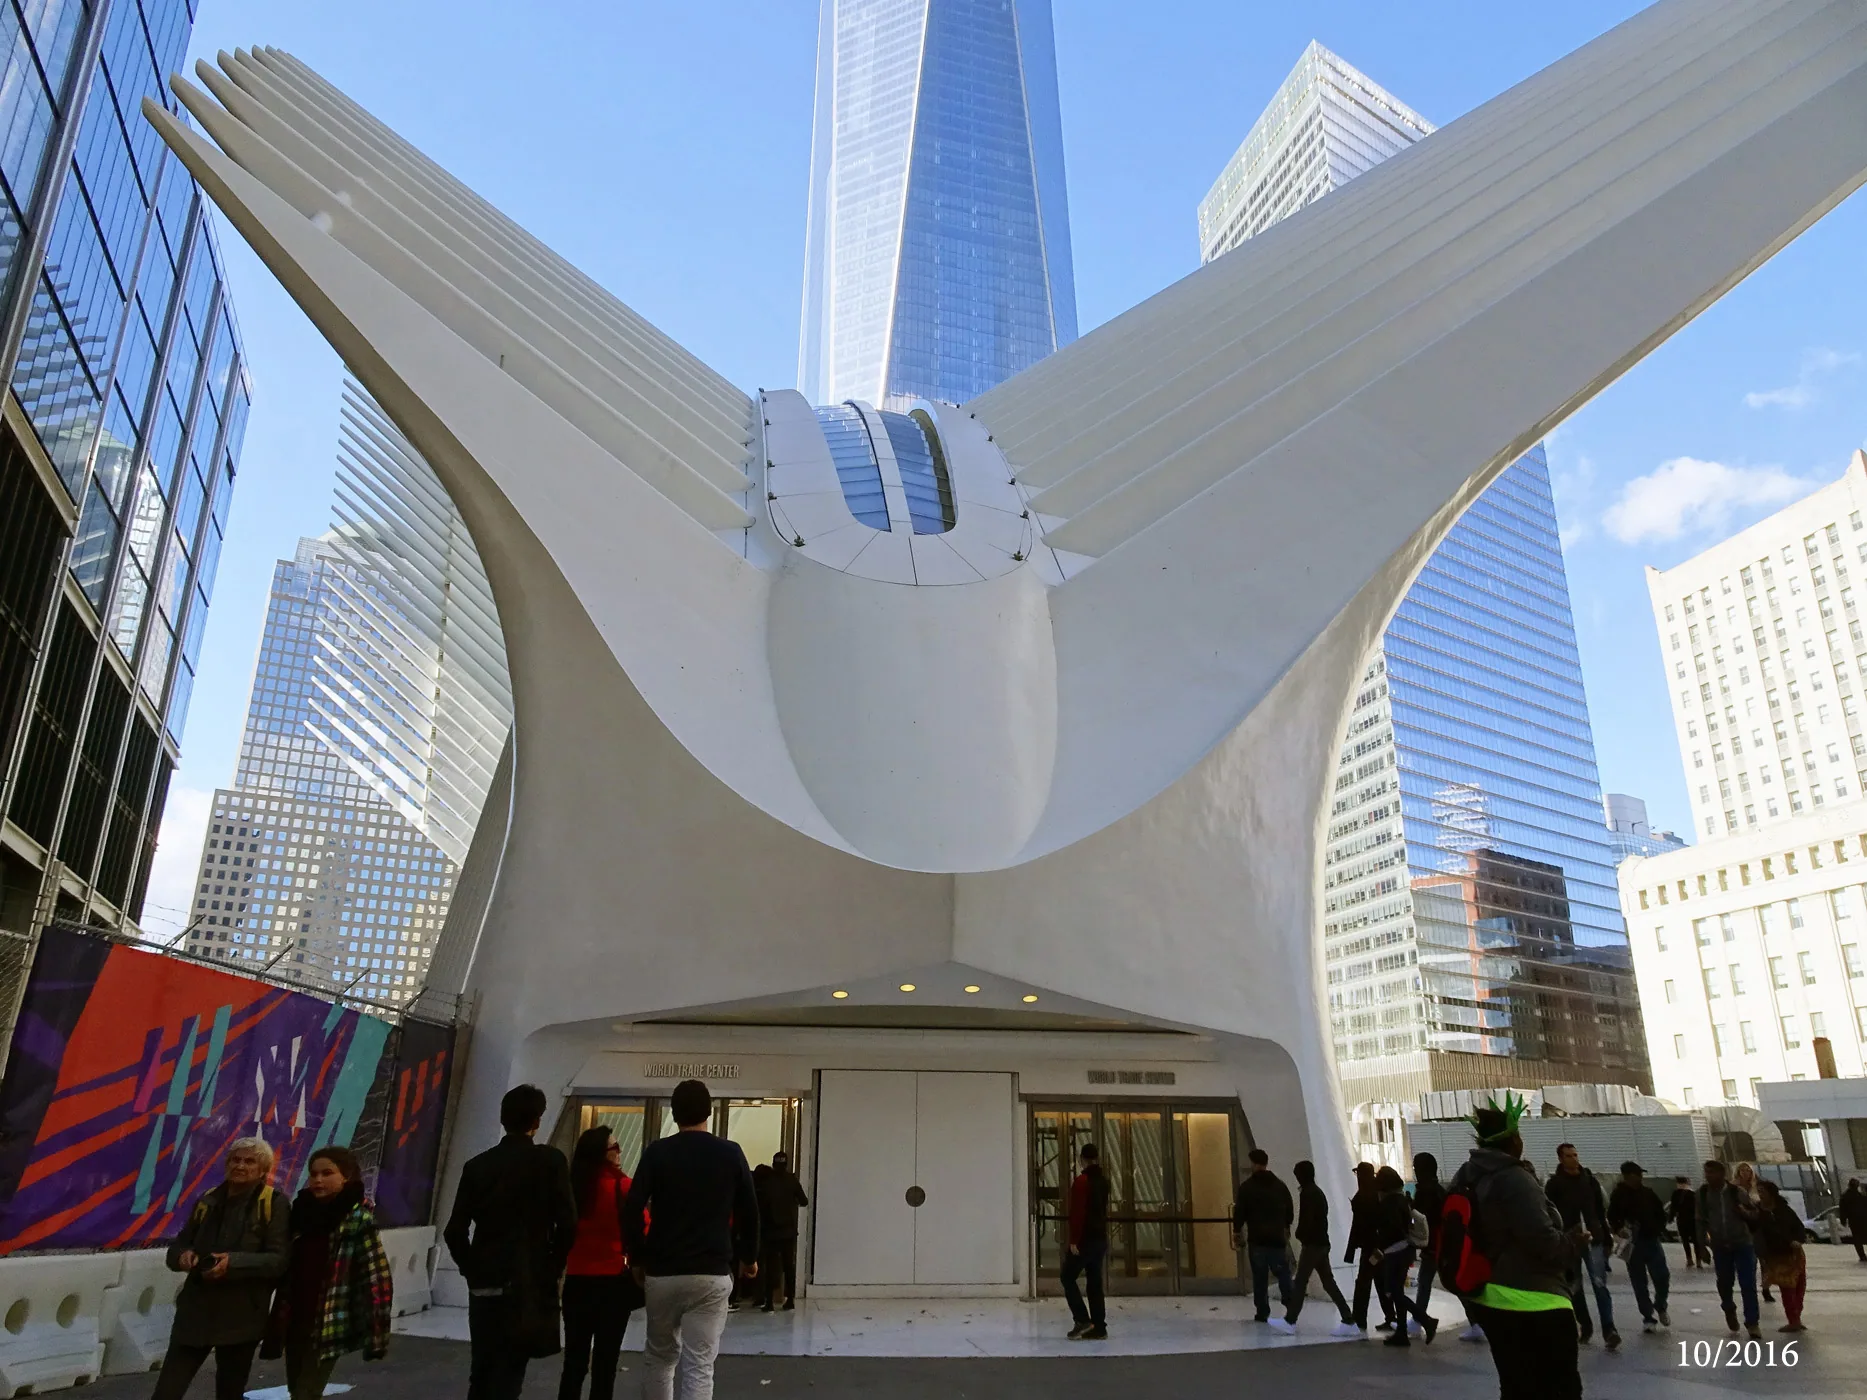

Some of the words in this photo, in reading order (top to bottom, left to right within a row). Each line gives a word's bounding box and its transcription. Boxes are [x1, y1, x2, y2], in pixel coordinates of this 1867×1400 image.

[644, 1063, 674, 1077] WORLD
[677, 1063, 705, 1078] TRADE
[706, 1064, 740, 1078] CENTER
